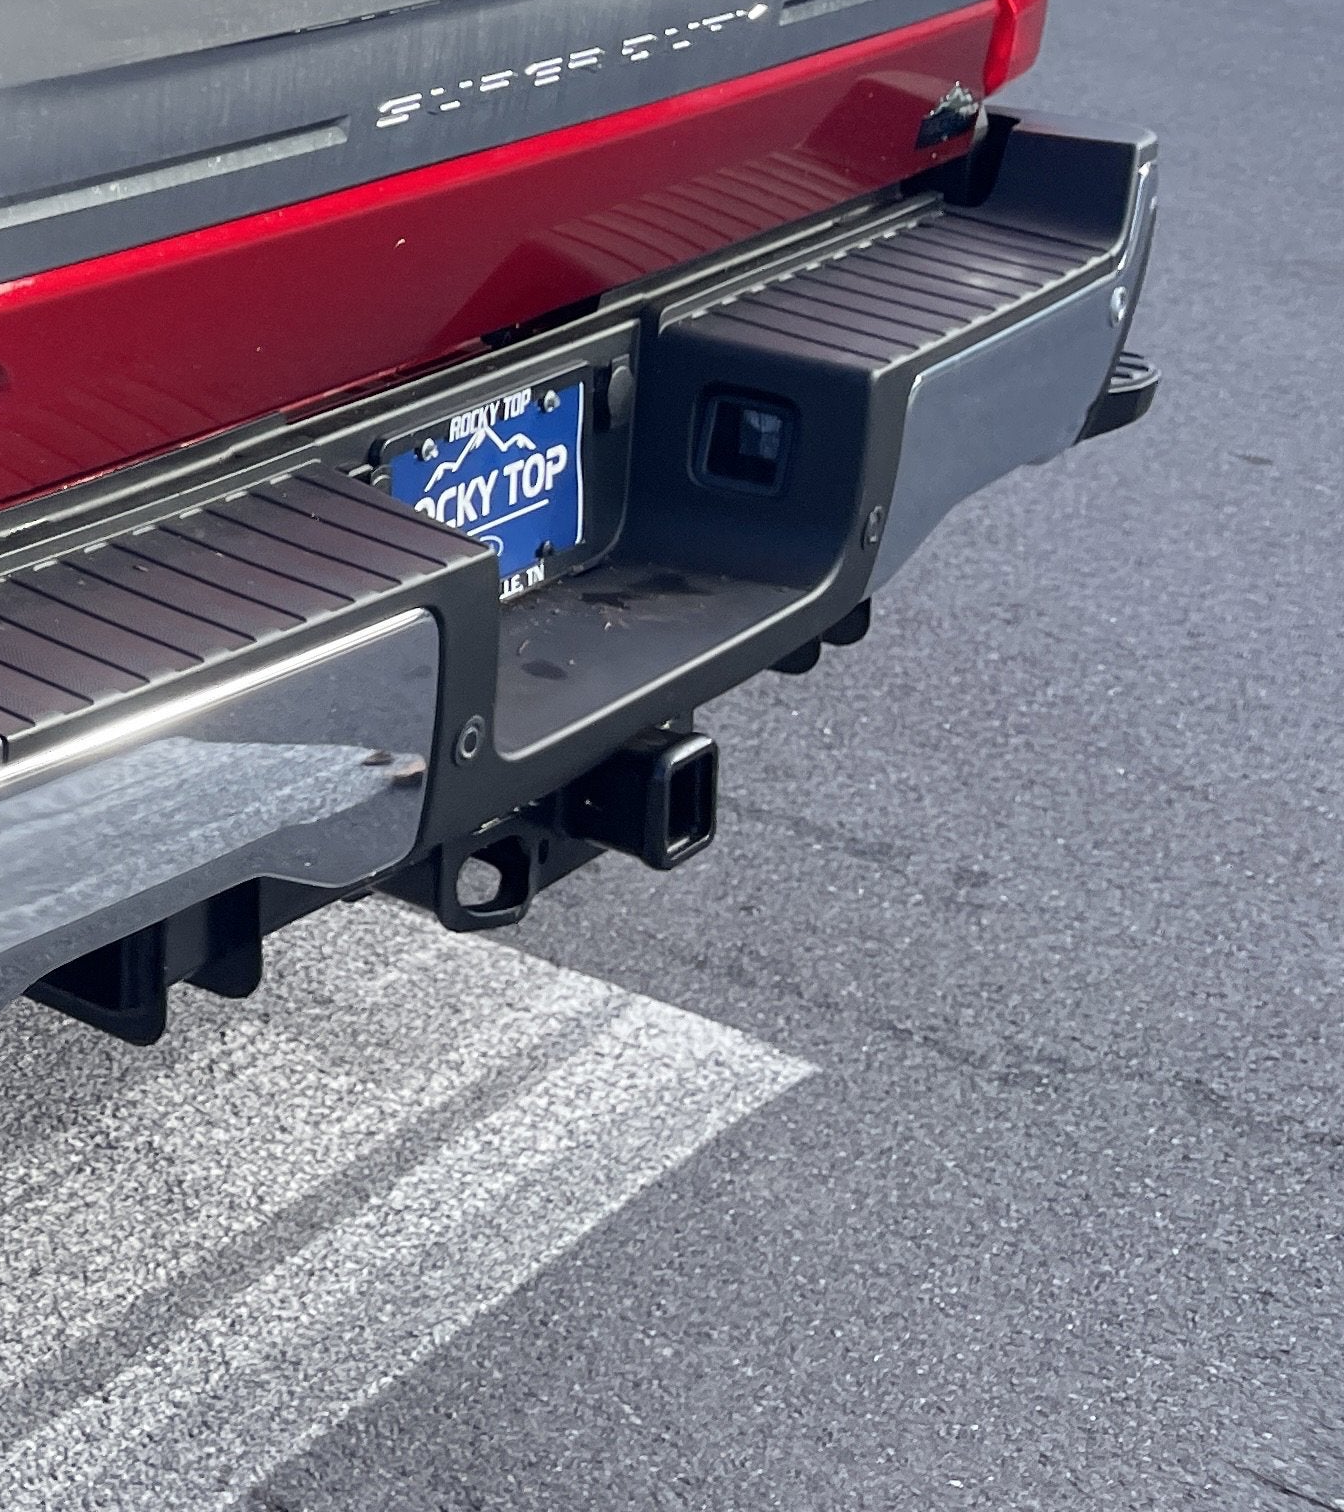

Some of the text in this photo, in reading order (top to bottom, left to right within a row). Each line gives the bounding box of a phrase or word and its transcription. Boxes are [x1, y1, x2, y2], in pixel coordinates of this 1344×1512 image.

[448, 388, 532, 443] ROCKY TOP
[503, 444, 568, 506] TOP
